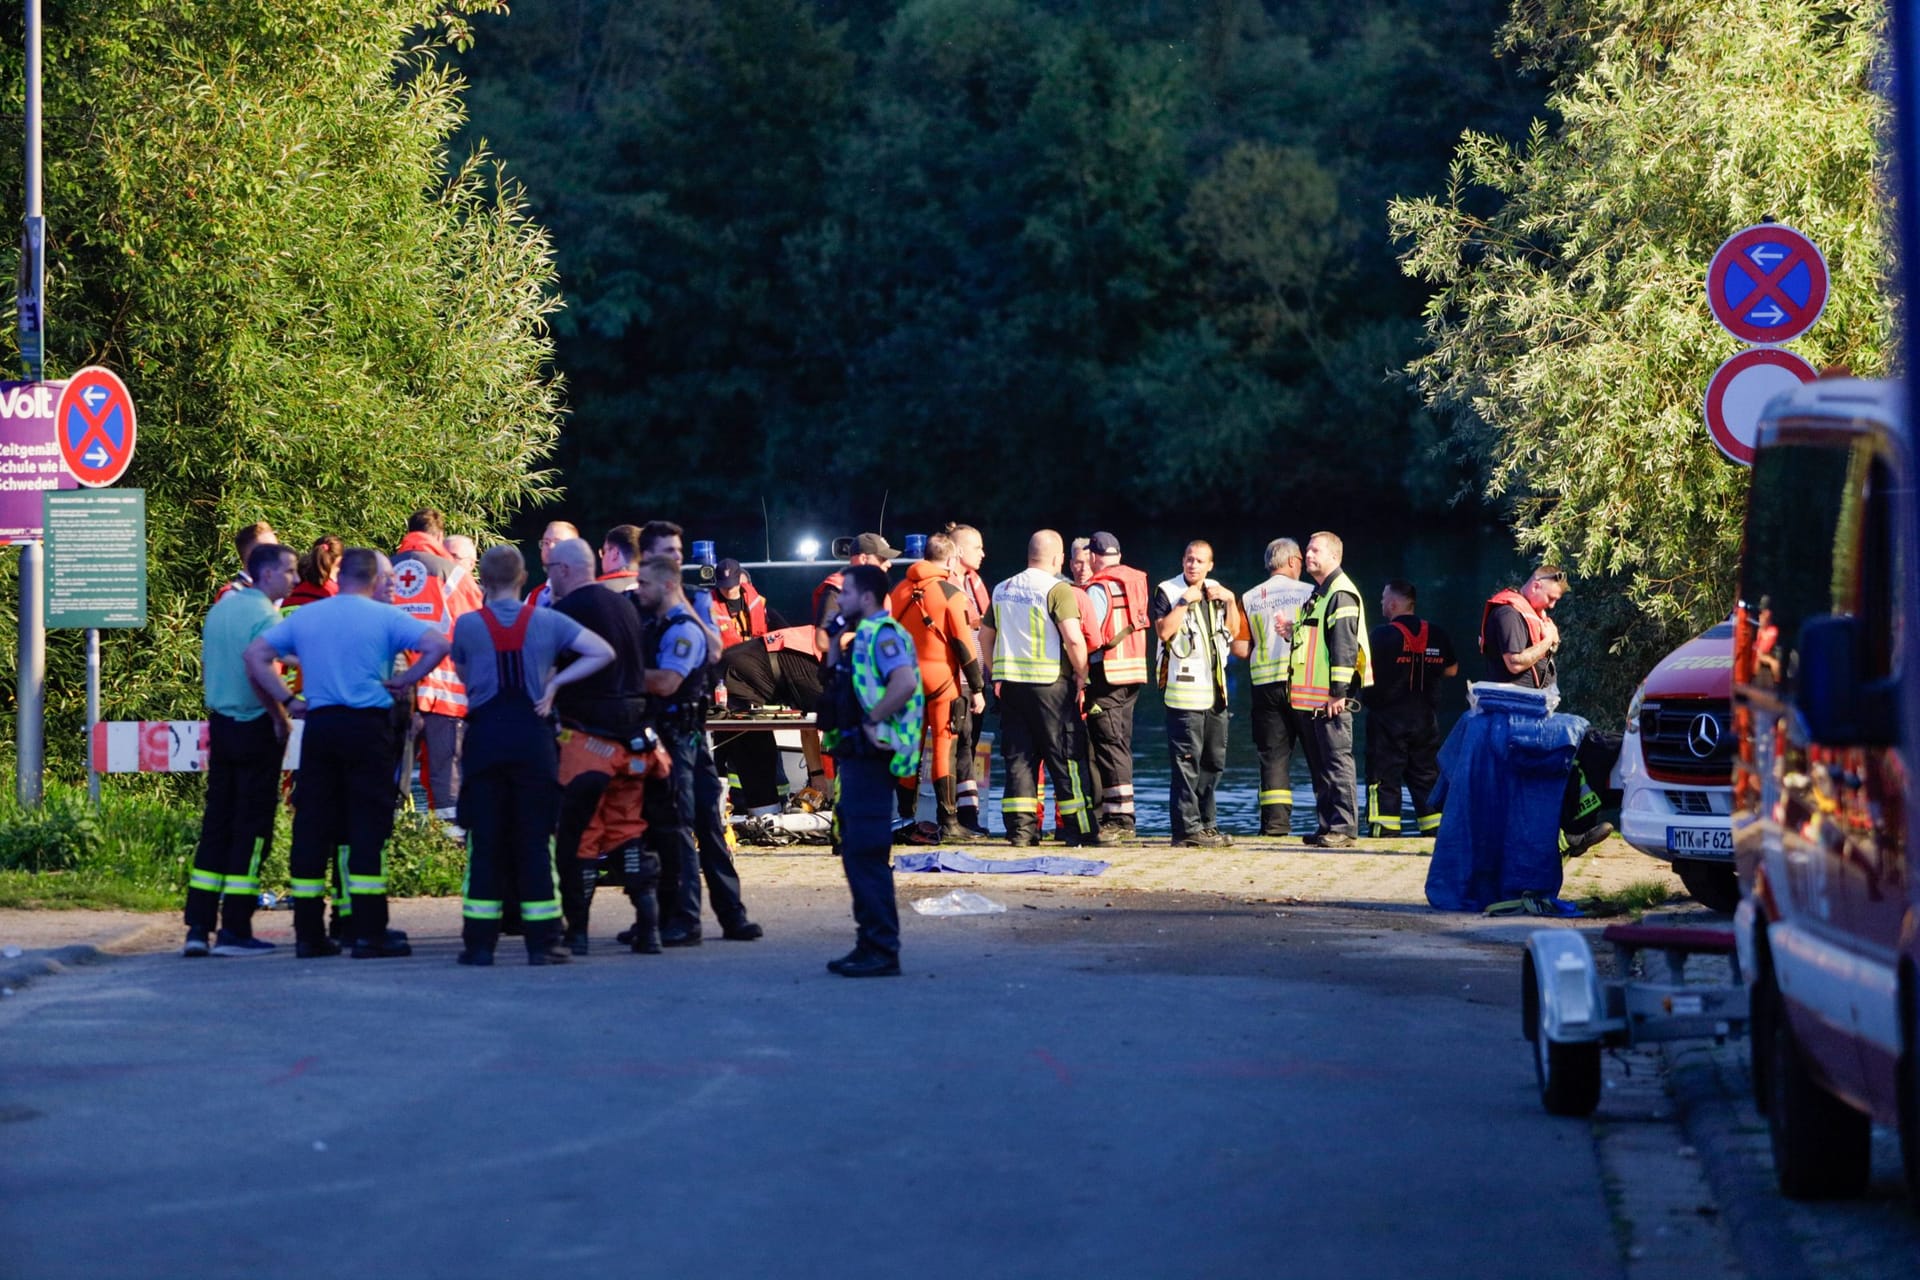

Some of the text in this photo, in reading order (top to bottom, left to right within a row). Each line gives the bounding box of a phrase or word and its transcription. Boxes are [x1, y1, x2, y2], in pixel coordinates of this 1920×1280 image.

[0, 387, 55, 419] Volt
[38, 459, 58, 473] wie
[1674, 830, 1695, 849] MTK
[1702, 831, 1710, 849] F
